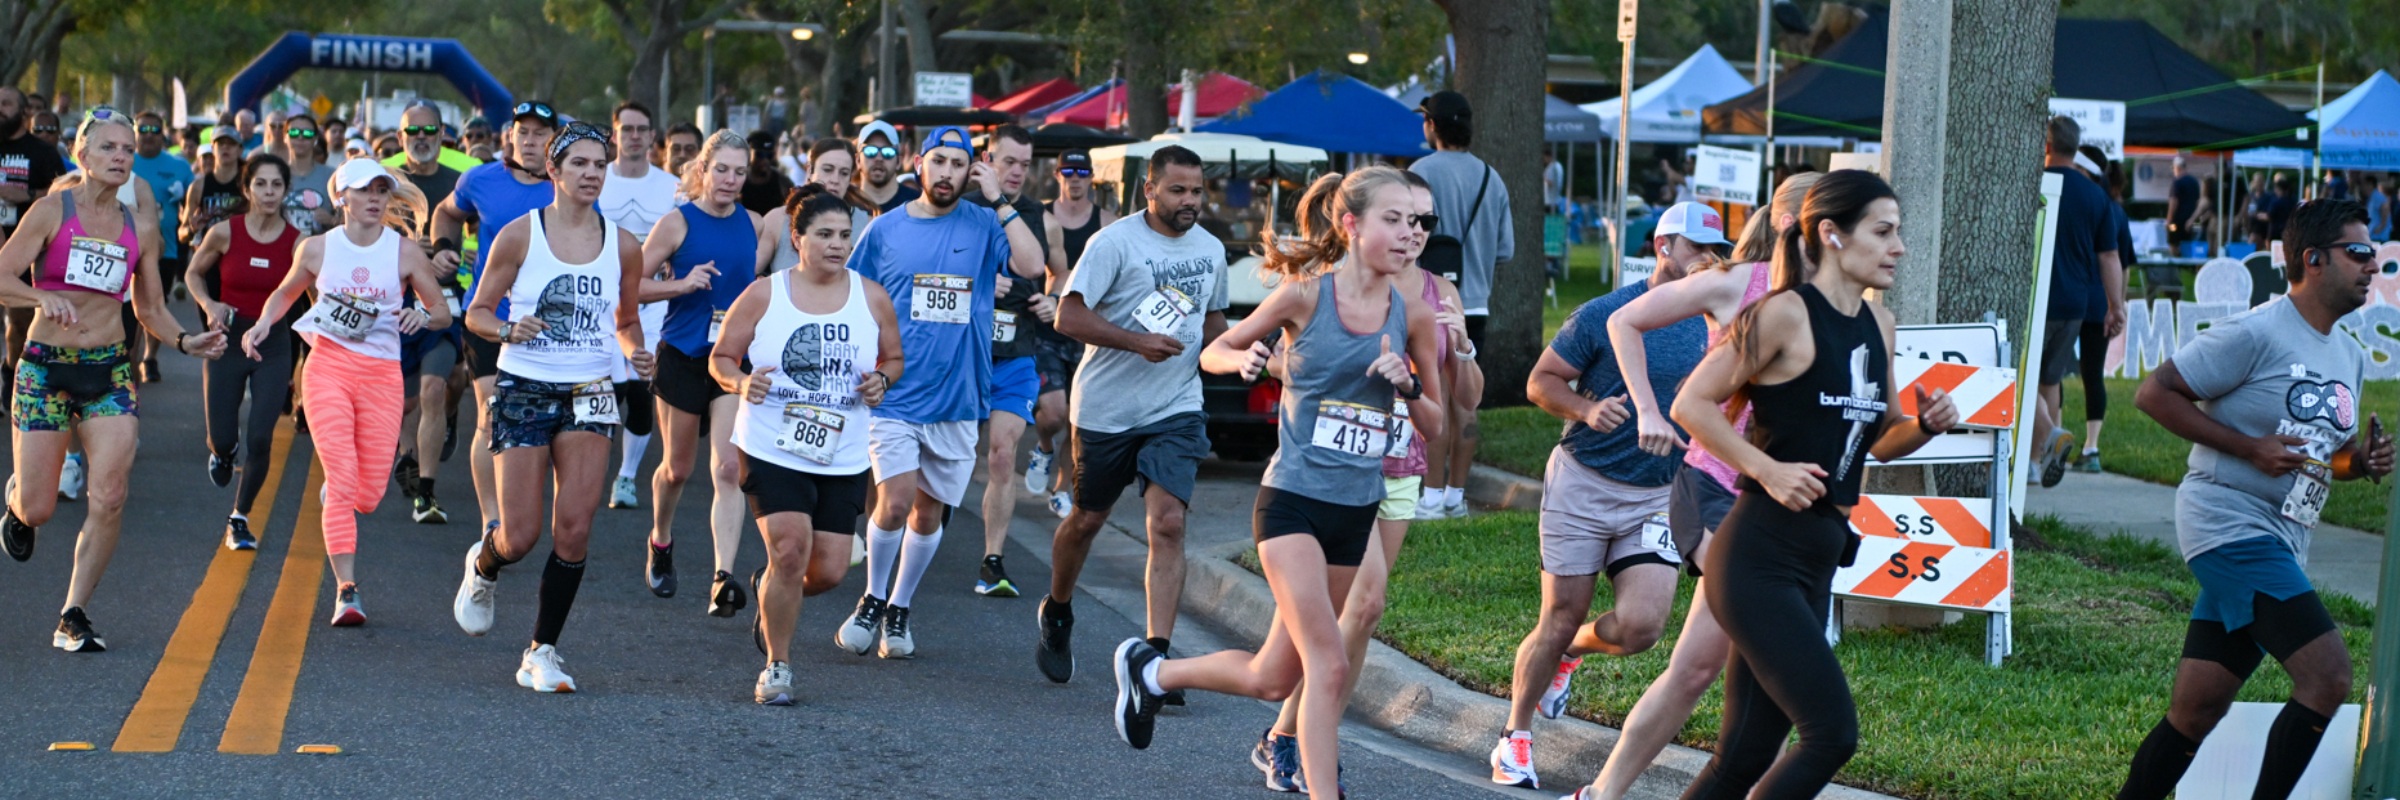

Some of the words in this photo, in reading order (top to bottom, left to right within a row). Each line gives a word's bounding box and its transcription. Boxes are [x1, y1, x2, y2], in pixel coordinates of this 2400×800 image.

[311, 39, 432, 69] FINISH
[83, 254, 115, 278] 527
[1624, 262, 1656, 274] SURVI
[577, 275, 602, 296] GO
[926, 290, 957, 311] 958
[330, 305, 361, 330] 449
[573, 310, 593, 329] IN
[1150, 300, 1181, 330] 971
[823, 323, 850, 342] GO
[823, 343, 860, 359] GRAY
[823, 358, 841, 377] IN
[2289, 363, 2306, 378] 10
[823, 376, 851, 393] MAY
[778, 387, 799, 400] LOVE
[808, 392, 832, 404] HOPE
[840, 396, 857, 407] RUN
[794, 421, 828, 448] 868
[1333, 424, 1371, 455] 413
[1894, 514, 1935, 535] S.S
[1888, 552, 1941, 582] S.S
